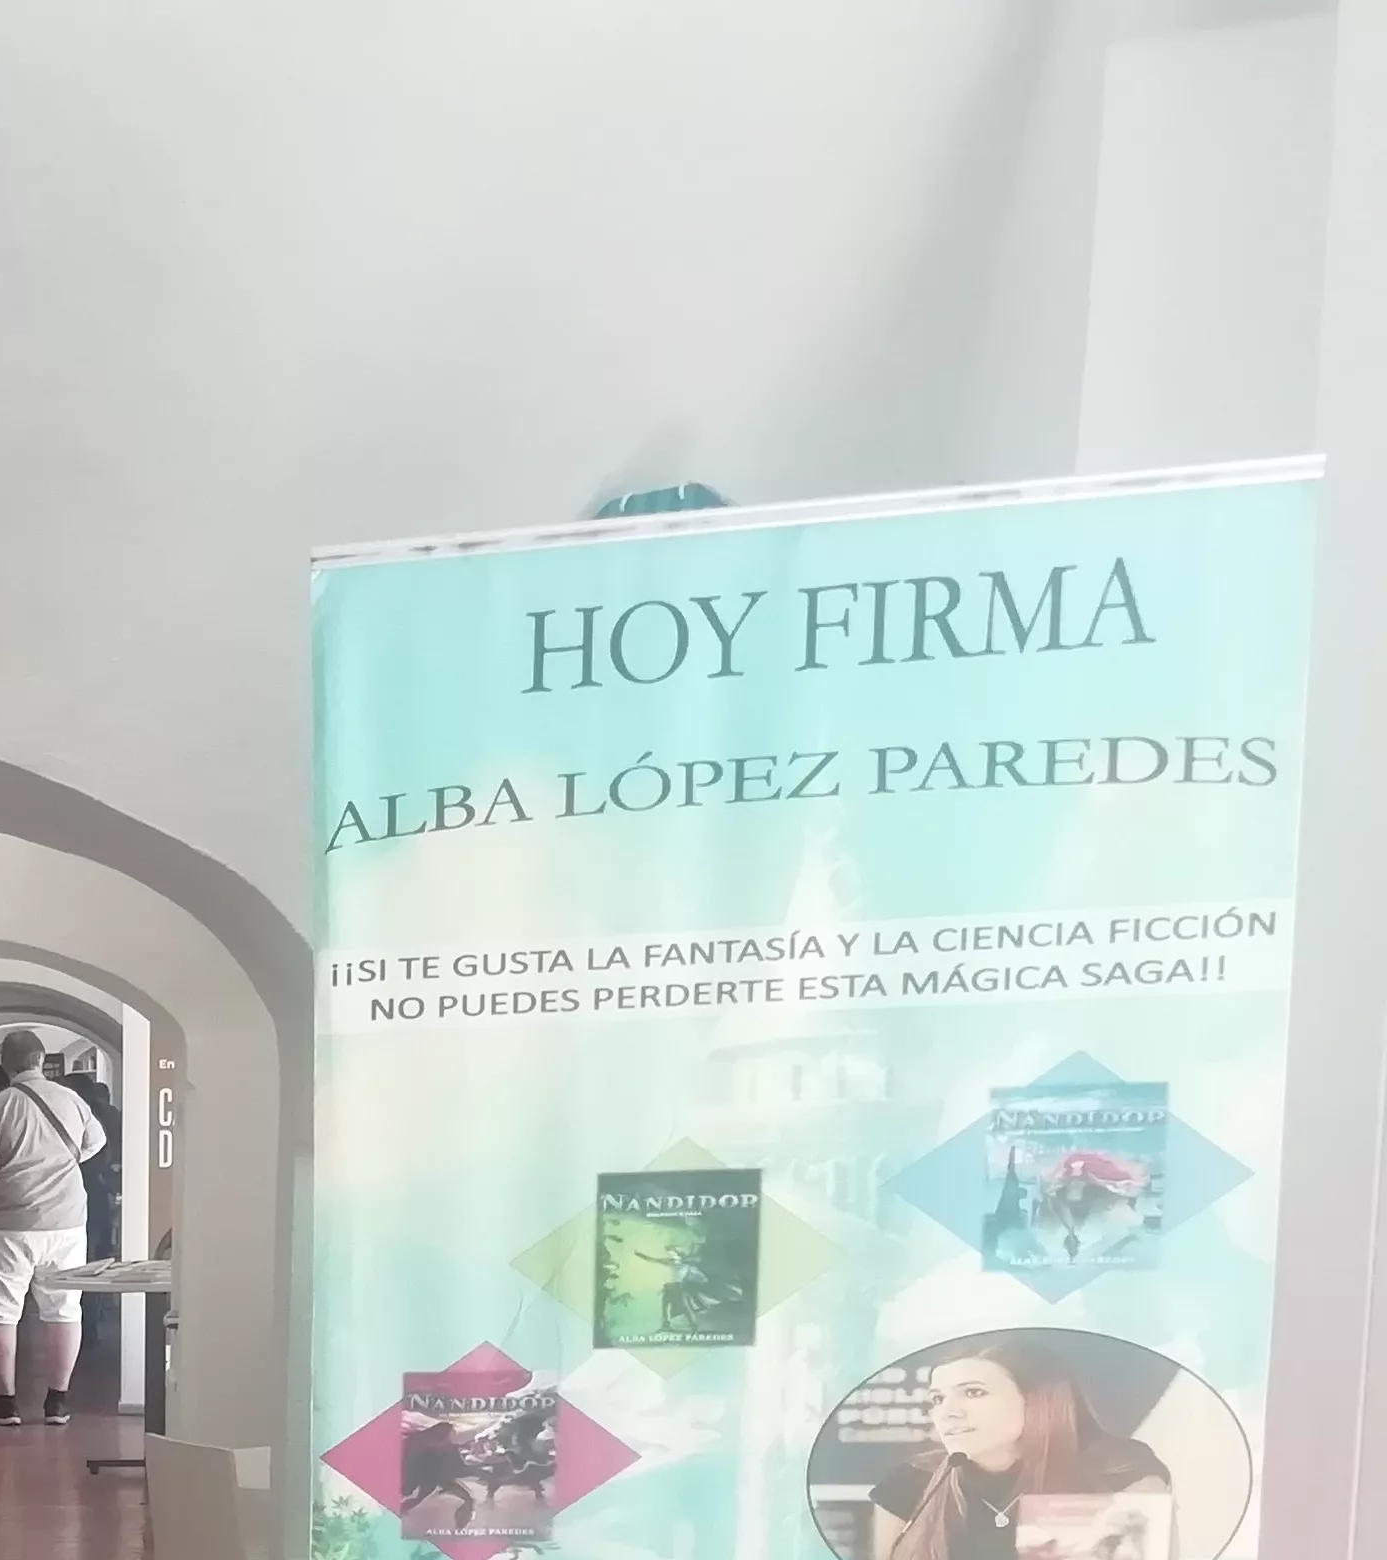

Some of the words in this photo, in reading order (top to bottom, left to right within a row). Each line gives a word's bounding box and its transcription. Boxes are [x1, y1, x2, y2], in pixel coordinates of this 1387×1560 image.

[521, 591, 767, 693] HOY
[794, 557, 1157, 672] FIRMA
[324, 777, 533, 855] ALBA
[555, 751, 840, 819] LÓPEZ
[868, 736, 1278, 794] PAREDES
[370, 996, 425, 1021] NO
[438, 989, 579, 1018] PUEDES
[593, 978, 784, 1011] PERDERTE
[799, 973, 887, 1001] ESTA
[902, 962, 1068, 996] MÁGICA
[1079, 955, 1226, 988] SAGA!!
[398, 957, 440, 980] TE
[452, 948, 574, 978] GUSTA
[587, 946, 631, 971] LA
[643, 929, 825, 967] FANTASÍA
[836, 933, 859, 957] Y
[873, 930, 919, 955] LA
[932, 920, 1094, 953] CIENCIA
[1109, 906, 1276, 944] FICCIÓN
